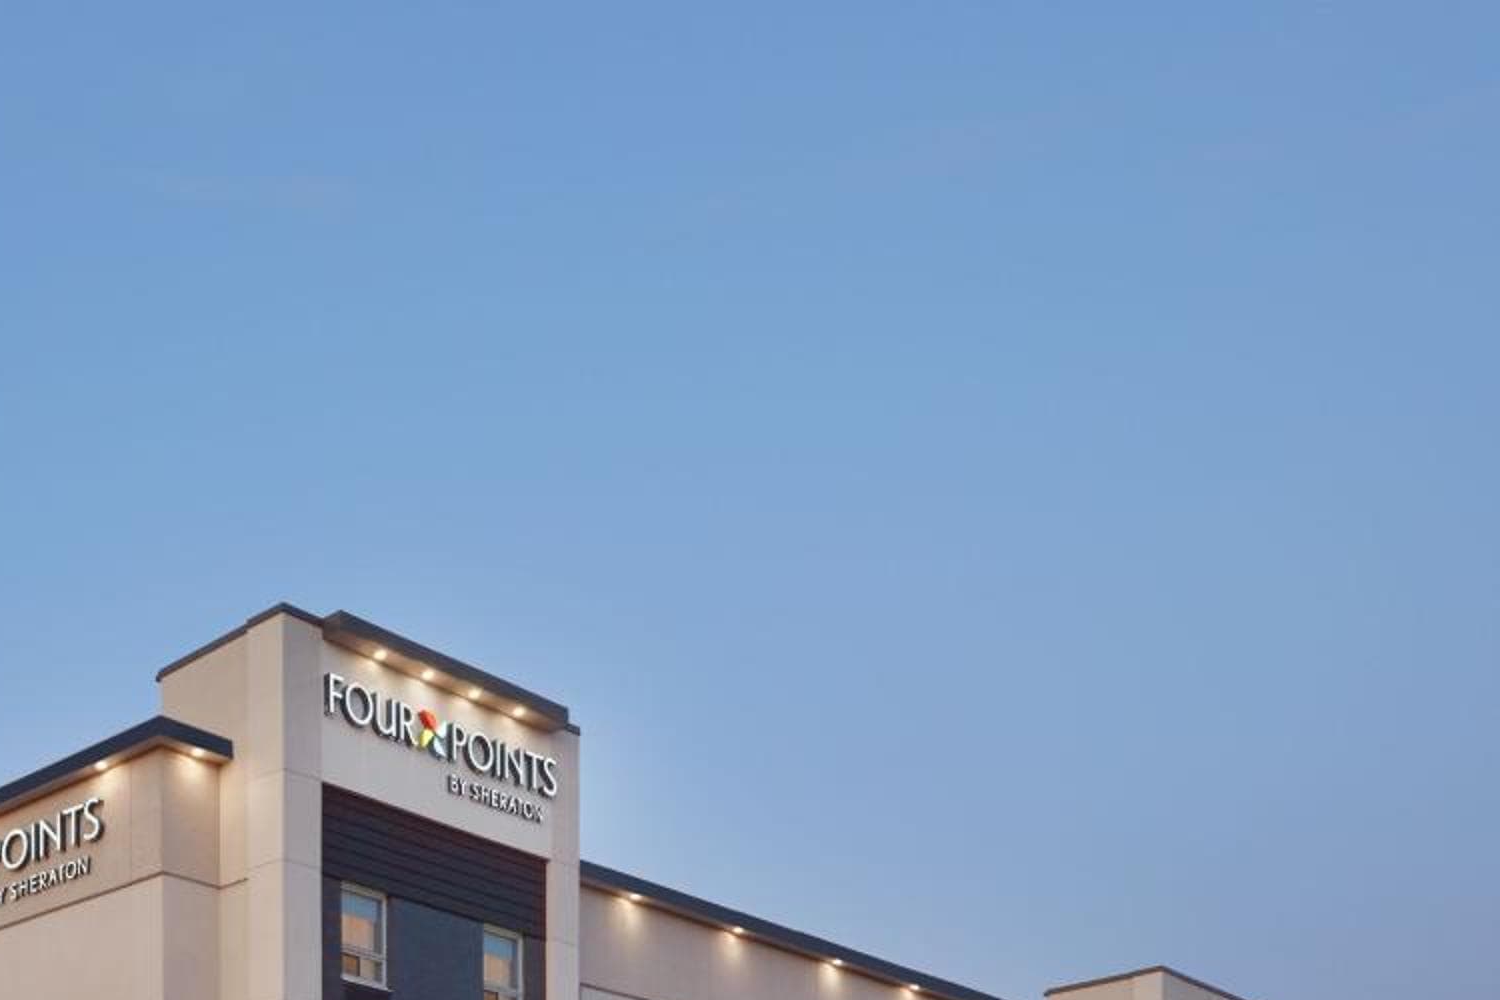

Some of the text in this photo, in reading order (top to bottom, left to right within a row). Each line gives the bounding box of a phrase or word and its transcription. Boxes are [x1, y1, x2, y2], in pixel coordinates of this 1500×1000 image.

[324, 672, 558, 798] FOUR POINTS
[449, 774, 543, 823] BY SHERATON
[10, 856, 91, 900] SHERATON
